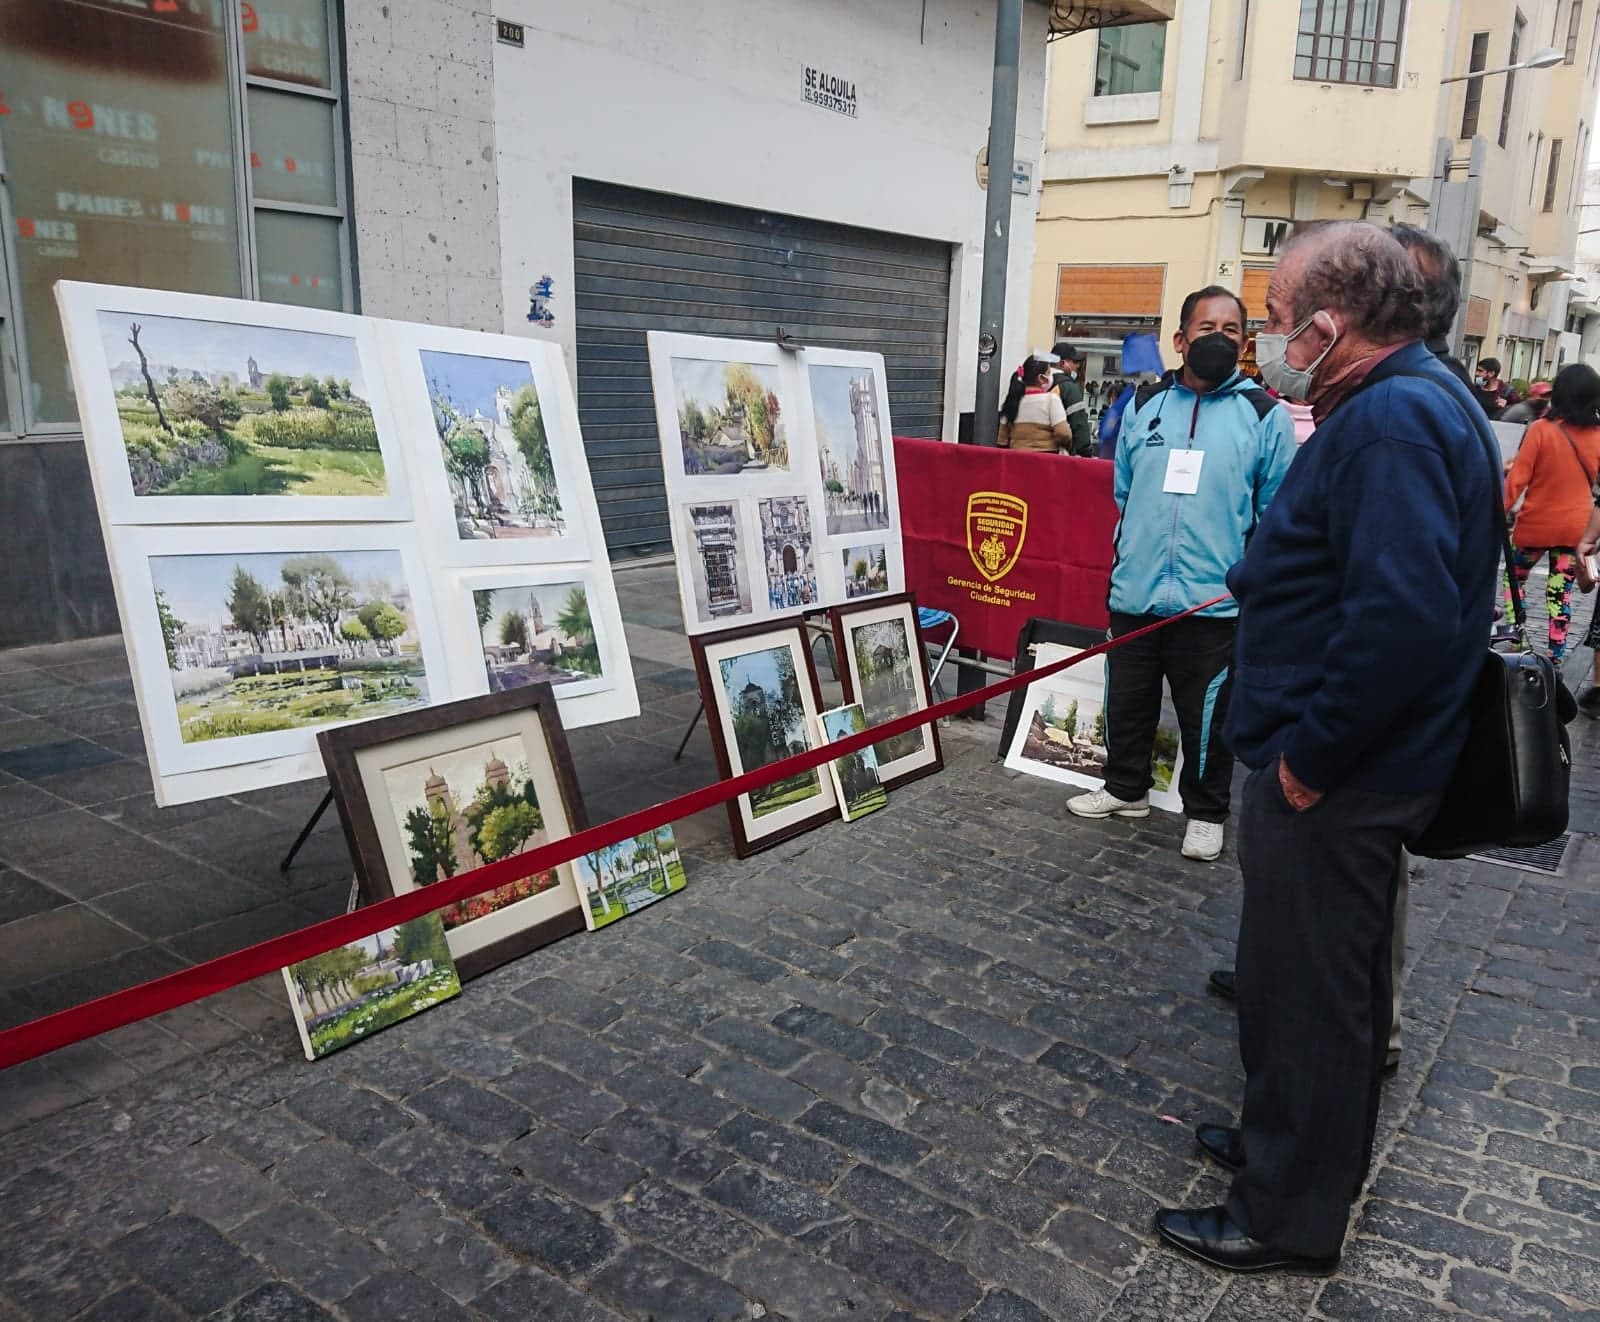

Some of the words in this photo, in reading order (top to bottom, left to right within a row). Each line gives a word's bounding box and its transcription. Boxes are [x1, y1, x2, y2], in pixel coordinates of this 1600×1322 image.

[805, 66, 817, 89] SE
[819, 72, 856, 102] ALQUILA
[813, 90, 856, 115] 959375317
[977, 518, 1015, 530] SEGURIDAD
[947, 576, 982, 591] Gerencia
[983, 583, 992, 593] de
[994, 585, 1036, 601] Seguridad
[970, 591, 1011, 607] Ciudadana
